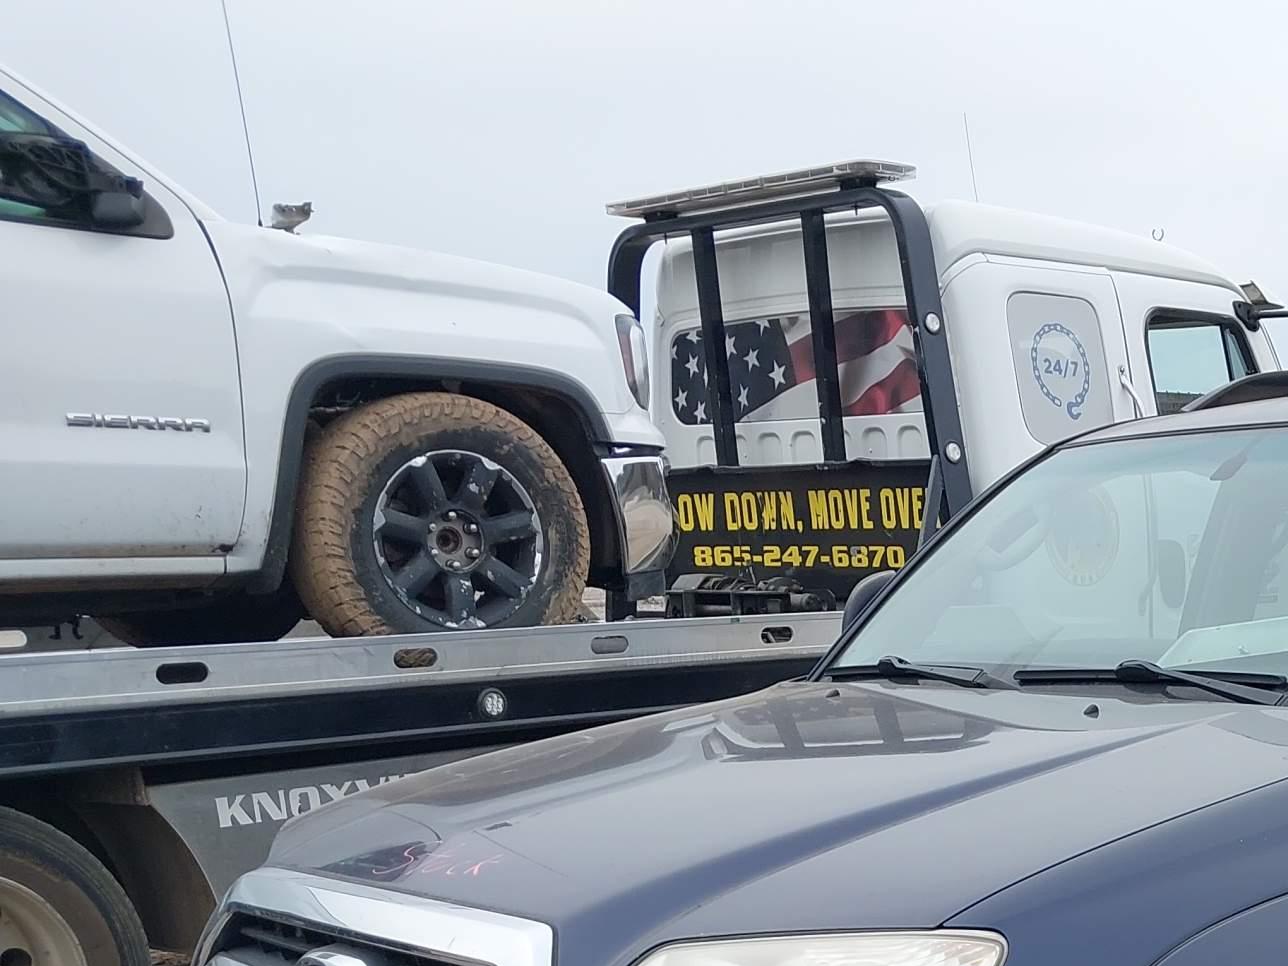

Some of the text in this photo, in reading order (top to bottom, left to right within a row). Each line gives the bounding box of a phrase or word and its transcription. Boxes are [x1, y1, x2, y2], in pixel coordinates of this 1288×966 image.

[1043, 358, 1079, 378] 24/7
[65, 411, 211, 433] SIERRA
[677, 493, 714, 532] OW
[724, 490, 803, 533] DOWN,
[807, 488, 873, 530] MOVE
[693, 545, 905, 567] 865-247-6870
[215, 774, 409, 828] KNOX
